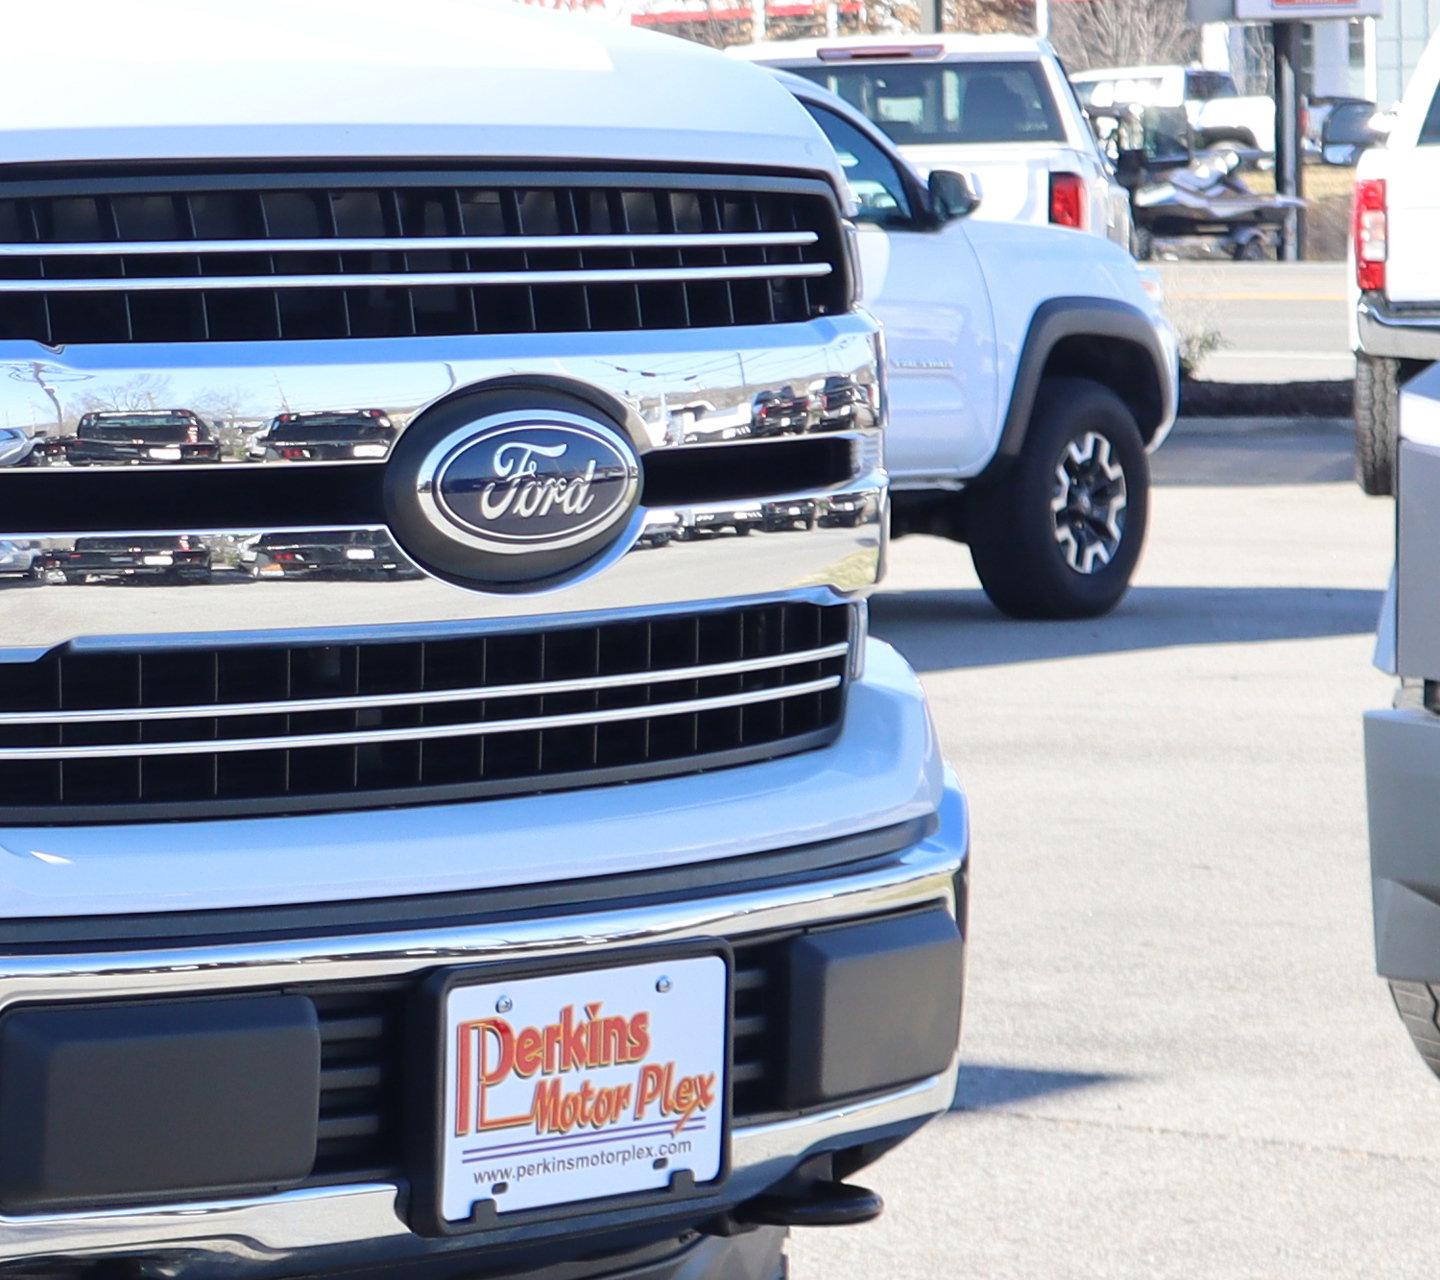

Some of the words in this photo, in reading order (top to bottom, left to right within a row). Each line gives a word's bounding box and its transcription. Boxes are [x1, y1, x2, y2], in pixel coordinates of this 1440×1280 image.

[480, 441, 597, 520] Ford
[454, 1001, 652, 1136] Perkins
[533, 1075, 634, 1134] Motor
[633, 1060, 717, 1138] Plex
[472, 1136, 693, 1185] www.perkinsmotorplex.com
